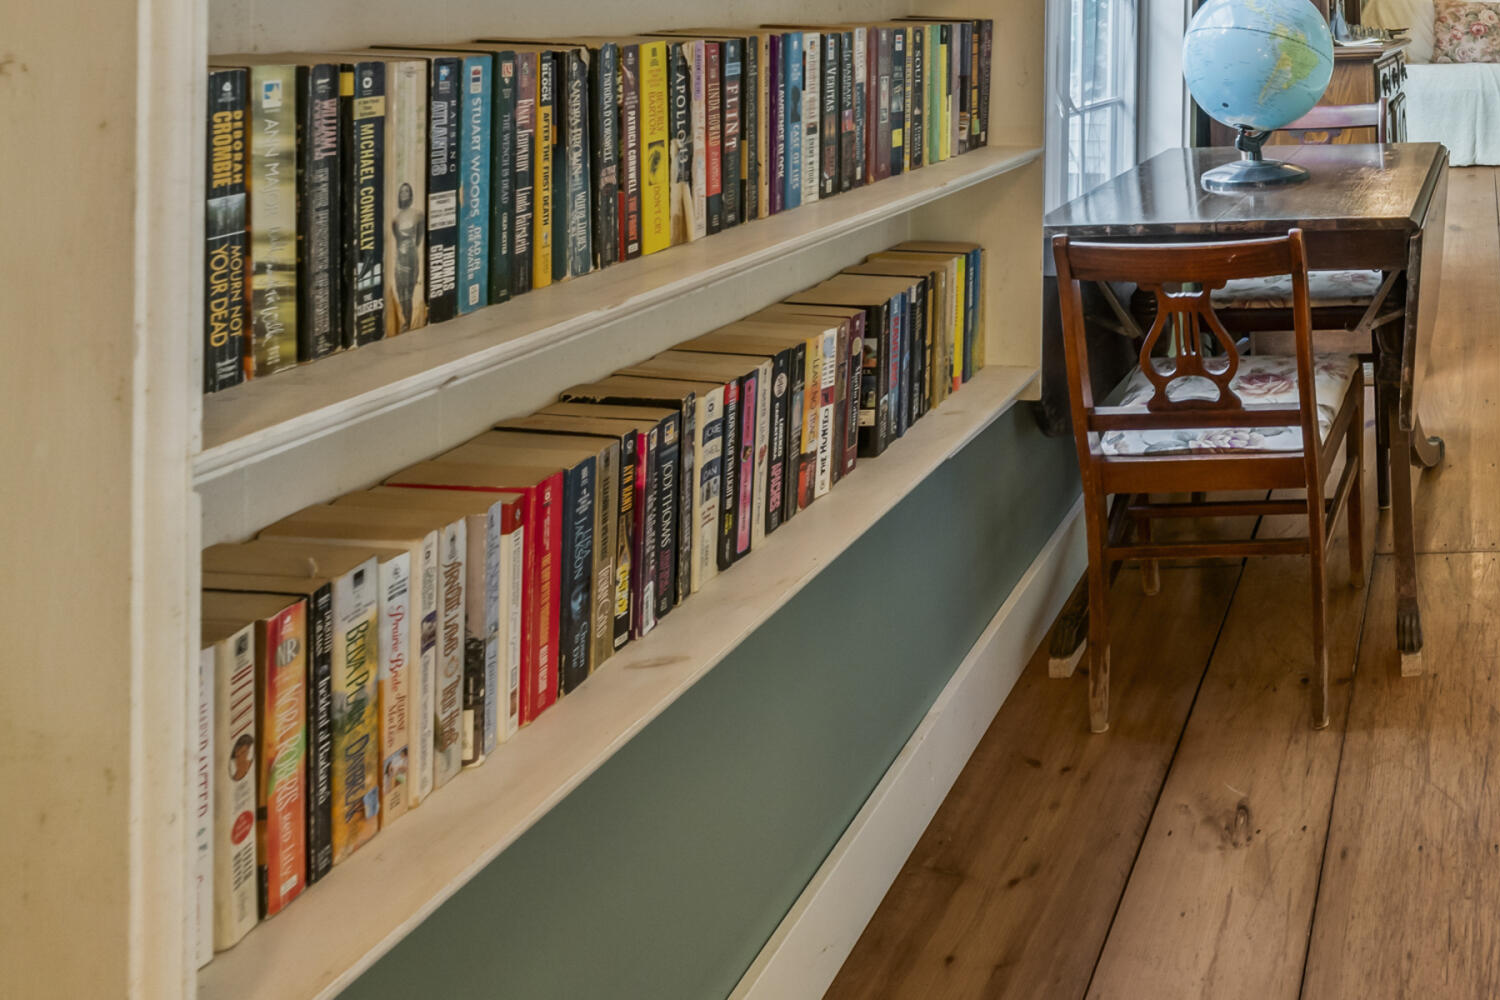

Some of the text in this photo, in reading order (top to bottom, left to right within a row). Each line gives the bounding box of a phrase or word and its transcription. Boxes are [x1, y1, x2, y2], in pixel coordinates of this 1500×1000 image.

[649, 91, 657, 136] BARTON
[676, 72, 689, 163] APOLLO 13
[708, 82, 721, 146] LINDA HOWARD
[725, 83, 739, 148] FLINT
[826, 68, 837, 112] VERITAS
[212, 111, 232, 189] CROMBIE
[234, 110, 244, 184] DEBORAH
[470, 97, 482, 217] STUART WOODS
[502, 133, 510, 166] WENCH
[570, 79, 582, 175] SANDRA BROWN
[629, 111, 637, 148] PATRICIA
[360, 122, 375, 251] MICHAEL CONNELLY
[515, 98, 534, 254] FINAL JEOPARDY Linda Fairstein
[628, 150, 637, 194] CORNWELL
[793, 152, 799, 166] OF
[502, 179, 510, 204] DEAD
[474, 227, 482, 256] DEAD
[654, 216, 662, 236] CRY
[210, 243, 229, 348] YOUR DEAD
[230, 245, 243, 337] MOURN NOT
[430, 244, 443, 299] GREANIAS
[444, 244, 456, 291] THOMAS
[810, 386, 820, 411] NO
[811, 358, 821, 385] LEAVE
[621, 464, 634, 513] AYN RAND
[661, 460, 673, 548] JODI THOMAS
[574, 517, 587, 580] JACKSON
[584, 528, 592, 560] LISA
[387, 606, 405, 692] Prairie Bride
[580, 621, 588, 668] Chosen
[318, 677, 331, 741] Incident at
[344, 620, 370, 824] BELVA PLAIN DAYBREAK
[271, 683, 302, 812] NORA ROBERTS
